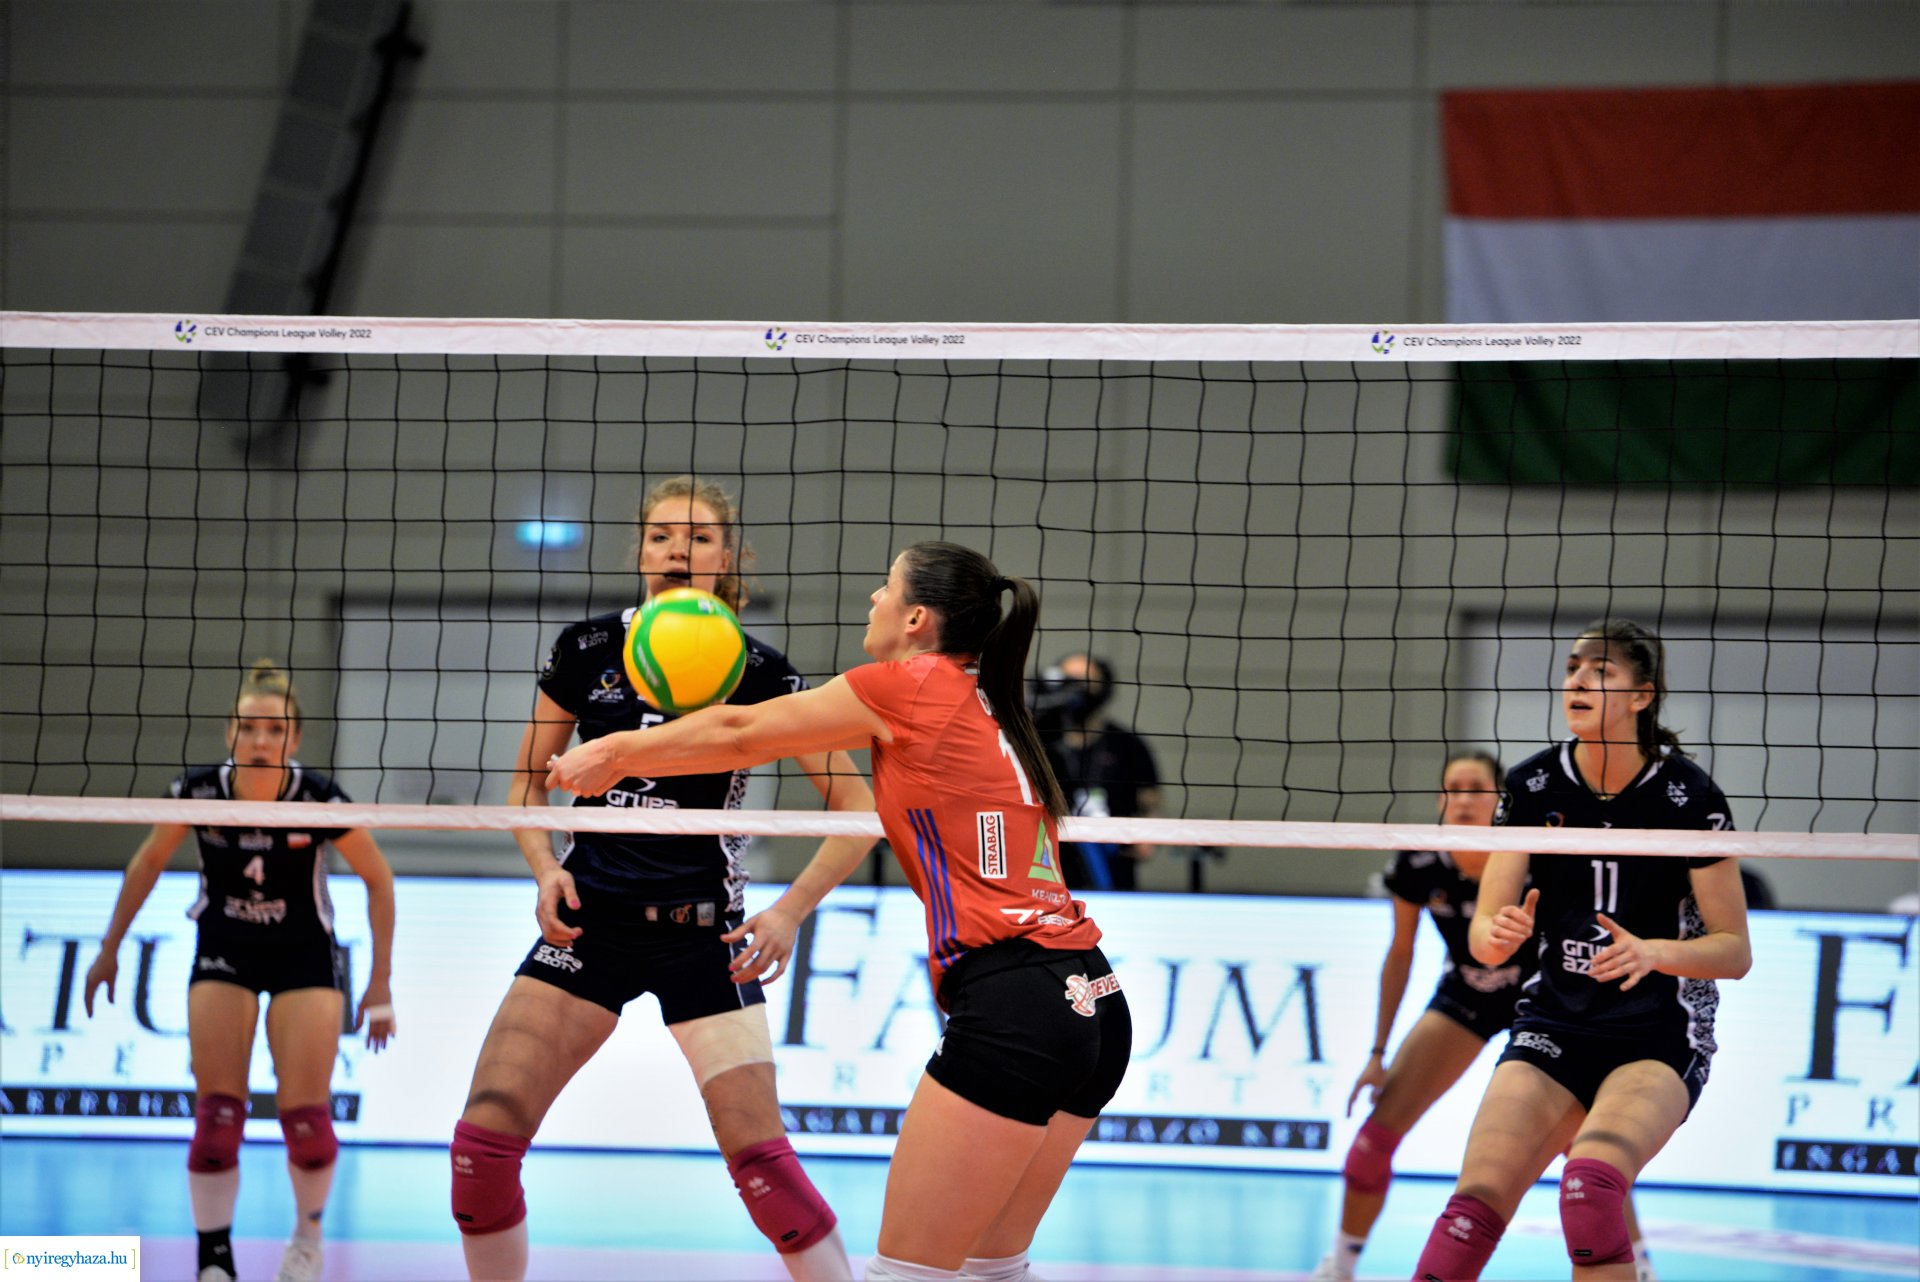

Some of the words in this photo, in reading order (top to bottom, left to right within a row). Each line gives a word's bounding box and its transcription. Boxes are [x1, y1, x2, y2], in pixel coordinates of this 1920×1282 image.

[204, 326, 225, 337] CEV
[227, 327, 279, 339] Champions
[281, 328, 316, 340] League
[318, 328, 347, 340] Volley
[349, 329, 372, 338] 2022
[795, 334, 815, 344] CEV
[817, 334, 870, 345] Champions
[873, 335, 908, 346] League
[910, 335, 940, 346] Volley
[942, 335, 965, 344] 2022
[1403, 337, 1424, 347] CEV
[1426, 337, 1482, 348] Champions
[1485, 336, 1521, 347] League
[1524, 336, 1555, 347] Volley
[1558, 335, 1582, 345] 2022
[981, 815, 998, 875] STRABAG
[243, 855, 265, 885] 4
[1591, 860, 1618, 913] 11
